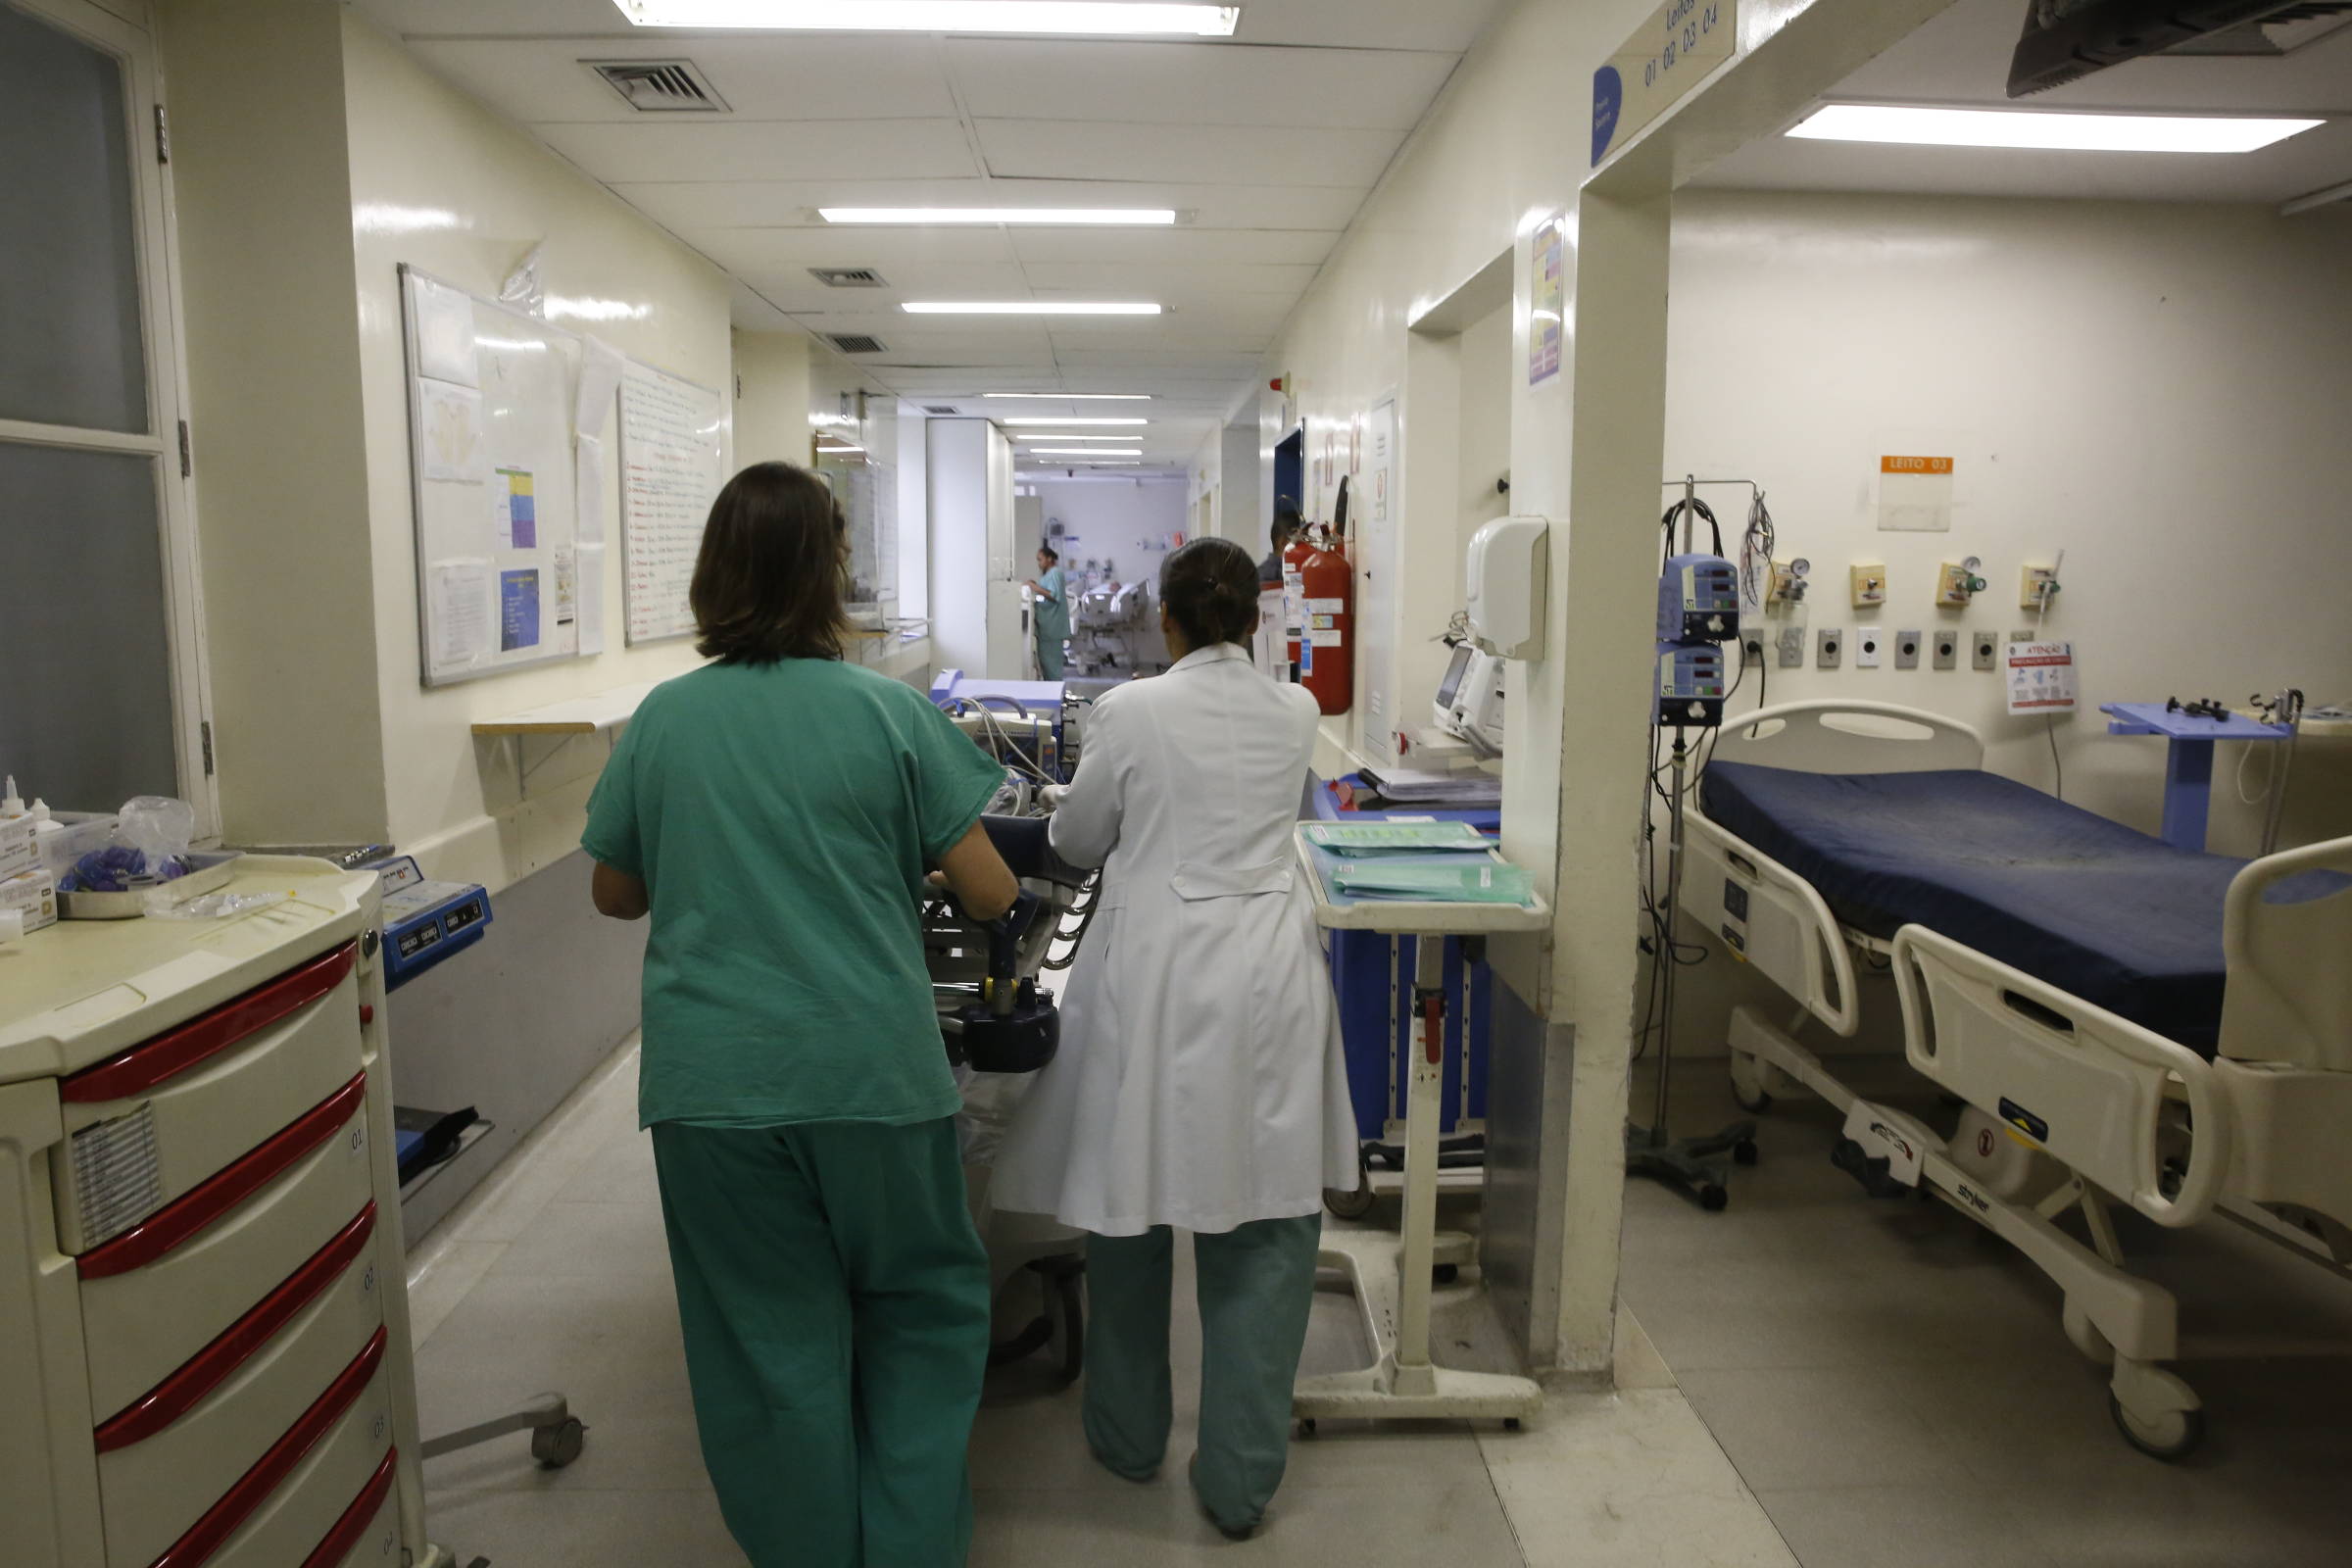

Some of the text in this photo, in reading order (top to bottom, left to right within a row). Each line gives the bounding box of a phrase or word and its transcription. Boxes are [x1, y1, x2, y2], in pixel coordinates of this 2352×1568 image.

[1645, 5, 1717, 87] 01 02 03 04
[1889, 457, 1947, 470] LEITO 03
[2027, 643, 2061, 655] ATENÇÃO
[352, 1128, 363, 1151] 01
